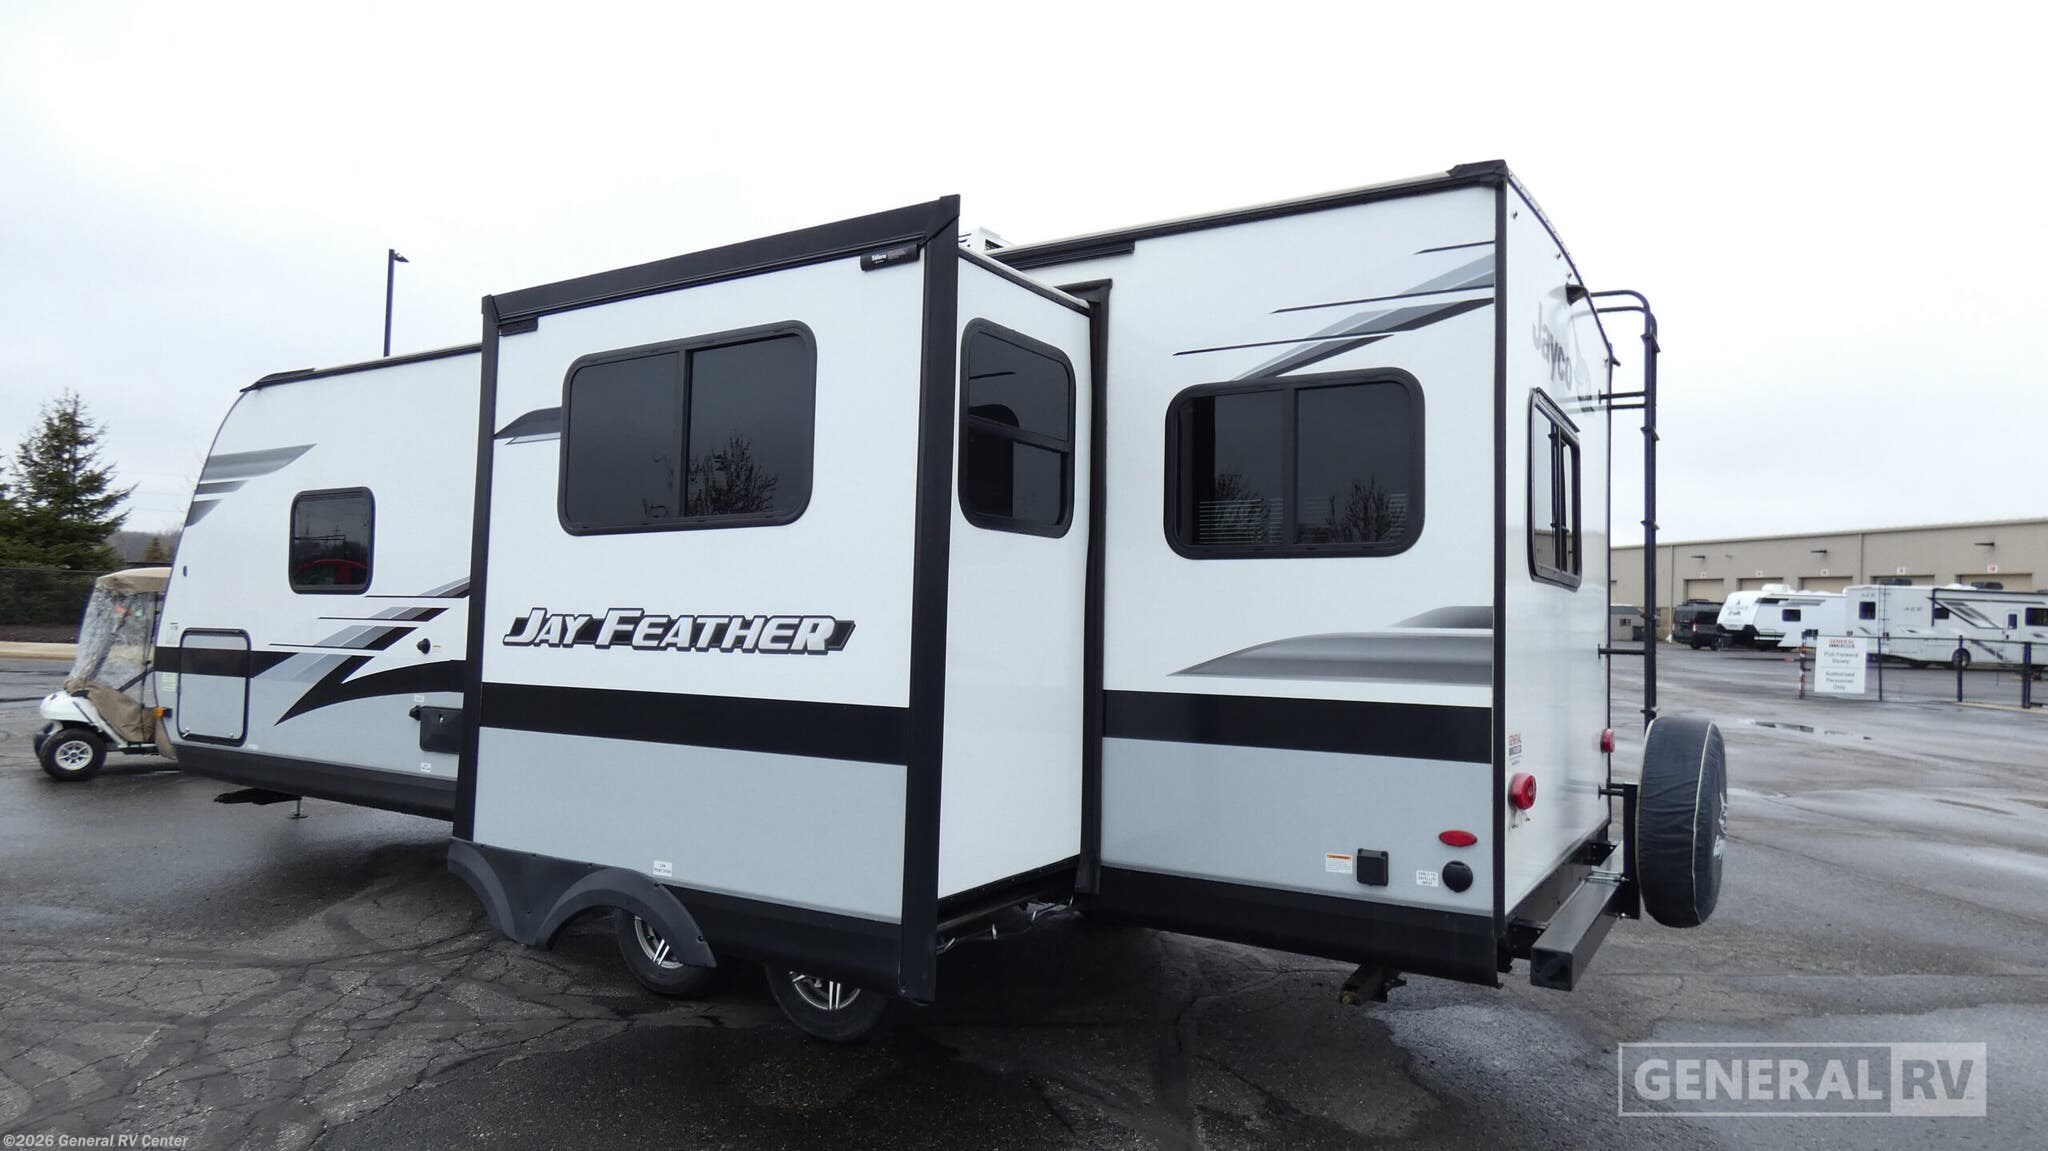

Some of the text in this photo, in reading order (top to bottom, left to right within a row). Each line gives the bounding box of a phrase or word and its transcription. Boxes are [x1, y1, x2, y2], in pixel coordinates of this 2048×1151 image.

[1531, 300, 1573, 390] Jayco
[503, 607, 837, 656] JAY FEATHER
